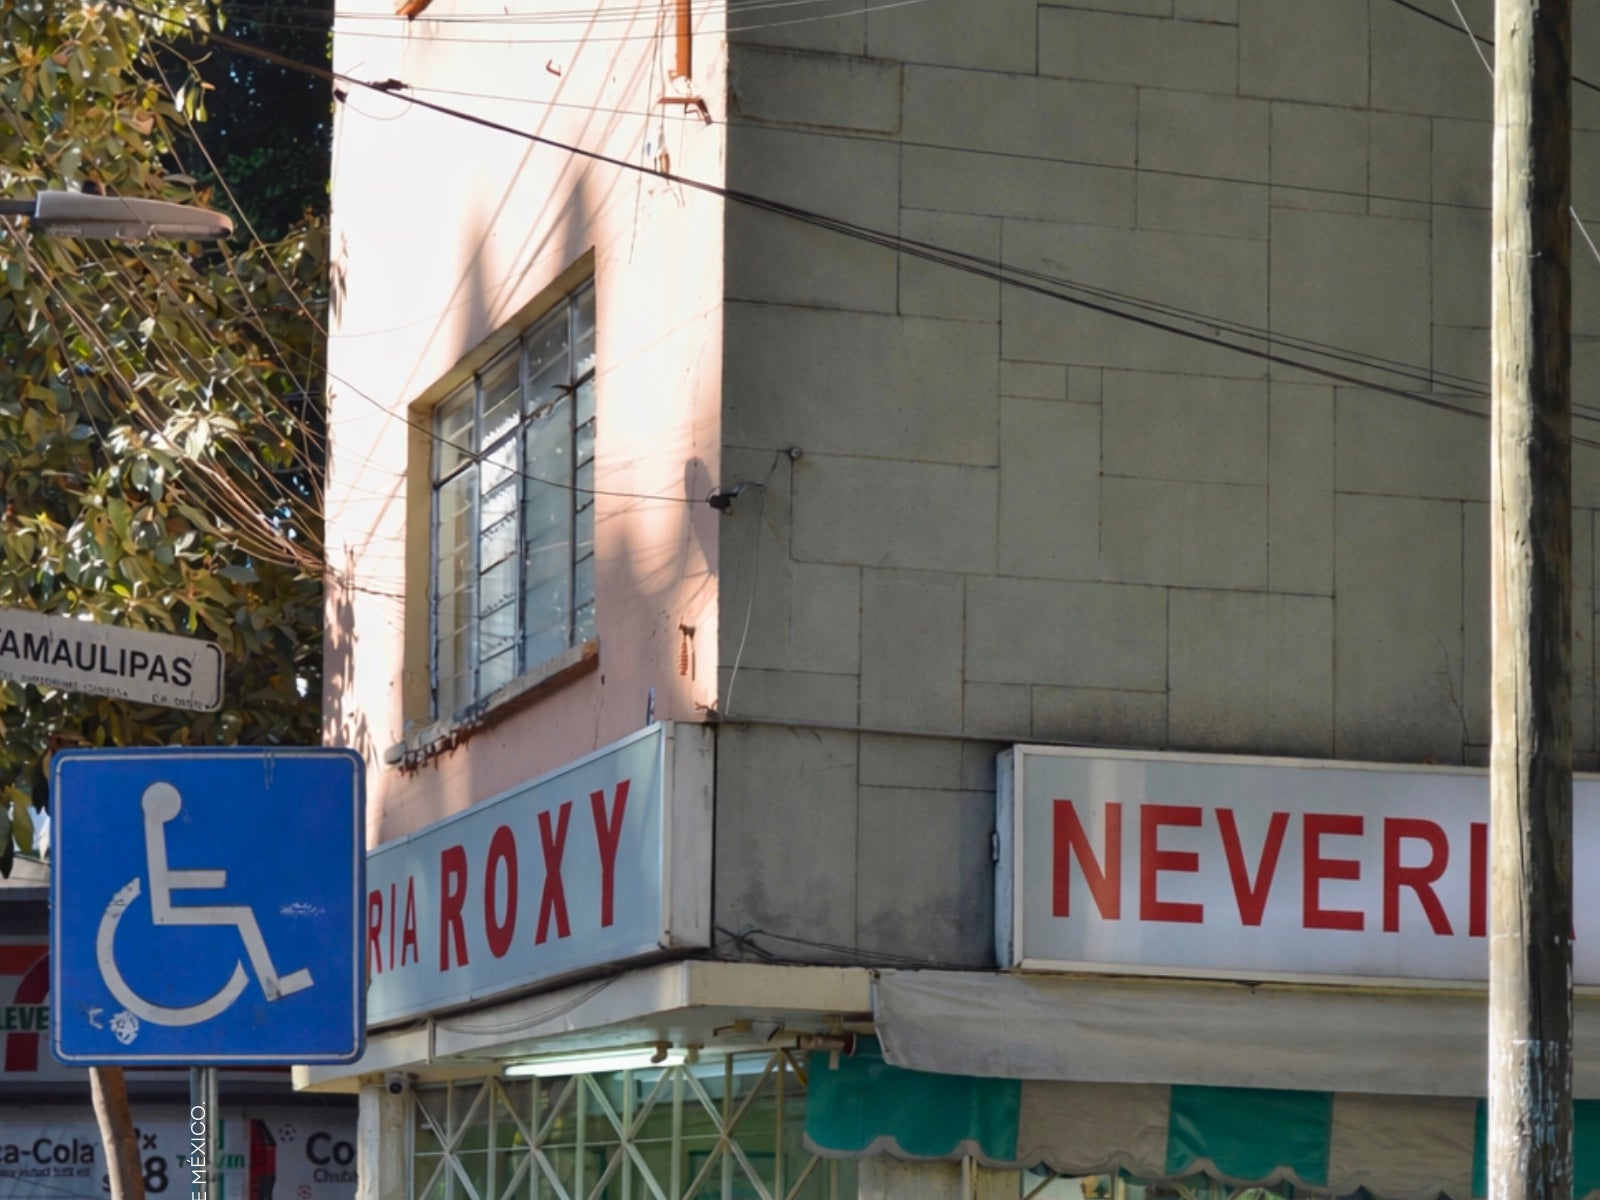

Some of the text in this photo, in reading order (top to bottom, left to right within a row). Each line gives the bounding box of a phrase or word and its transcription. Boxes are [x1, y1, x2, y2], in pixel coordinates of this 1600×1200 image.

[0, 629, 193, 687] AMAULIPAS
[439, 778, 631, 971] ROXY
[1051, 798, 1576, 942] NEVERI
